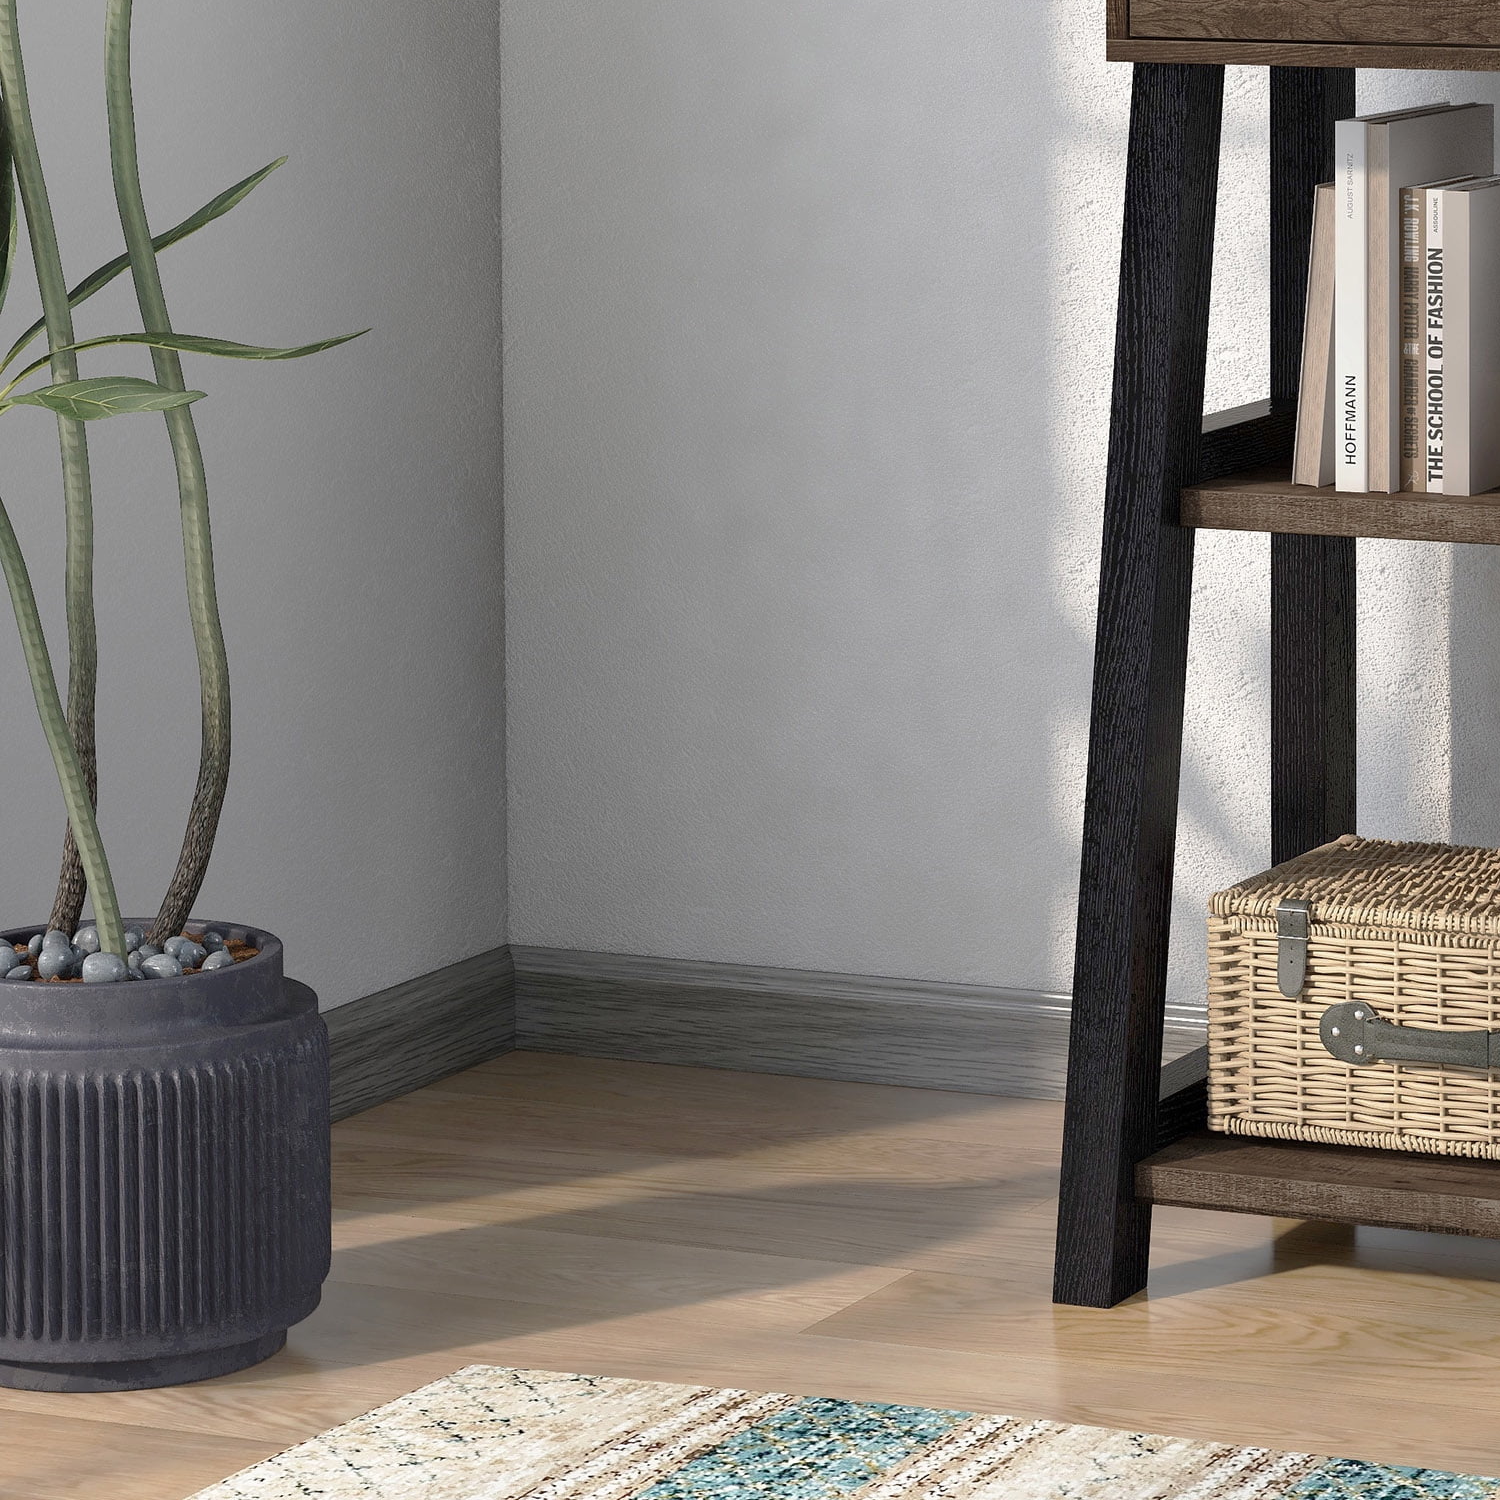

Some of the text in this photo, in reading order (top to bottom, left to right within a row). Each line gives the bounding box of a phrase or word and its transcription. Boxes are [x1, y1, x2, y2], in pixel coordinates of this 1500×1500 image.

[1346, 153, 1354, 219] AUGUST SARNITZ
[1403, 195, 1419, 215] J.K.
[1403, 218, 1419, 263] ROWLING
[1403, 266, 1419, 298] HARRY
[1403, 302, 1419, 340] POTTER
[1428, 248, 1443, 482] THE SCHOOL OF FASHION
[1345, 375, 1356, 465] HOFFMANN
[1403, 416, 1419, 458] SECRETS
